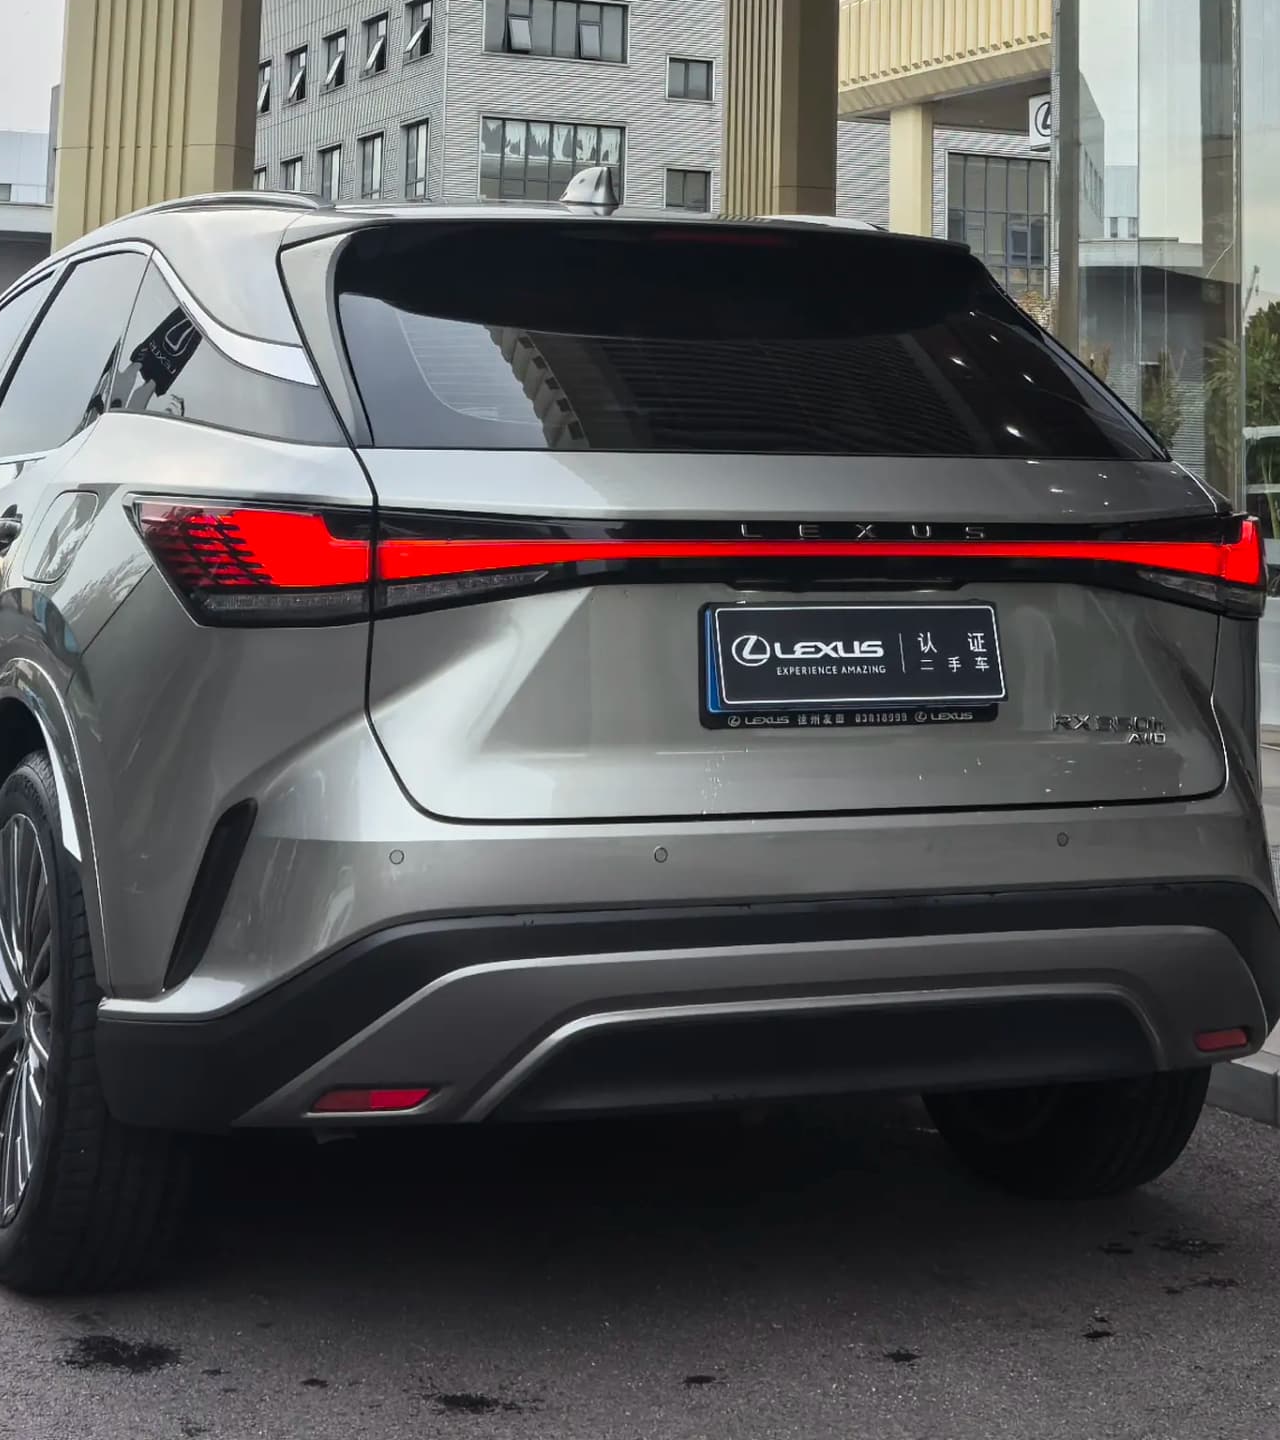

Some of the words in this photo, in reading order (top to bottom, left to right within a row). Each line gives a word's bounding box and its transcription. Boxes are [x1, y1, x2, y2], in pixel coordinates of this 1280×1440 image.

[741, 523, 986, 540] LEXUS
[774, 640, 884, 659] LEXUS
[776, 666, 838, 676] EXPERIENCE
[841, 665, 887, 675] AMAZING
[919, 656, 991, 672] 二手车
[745, 715, 790, 726] LEXUS
[930, 711, 973, 722] LEXUS
